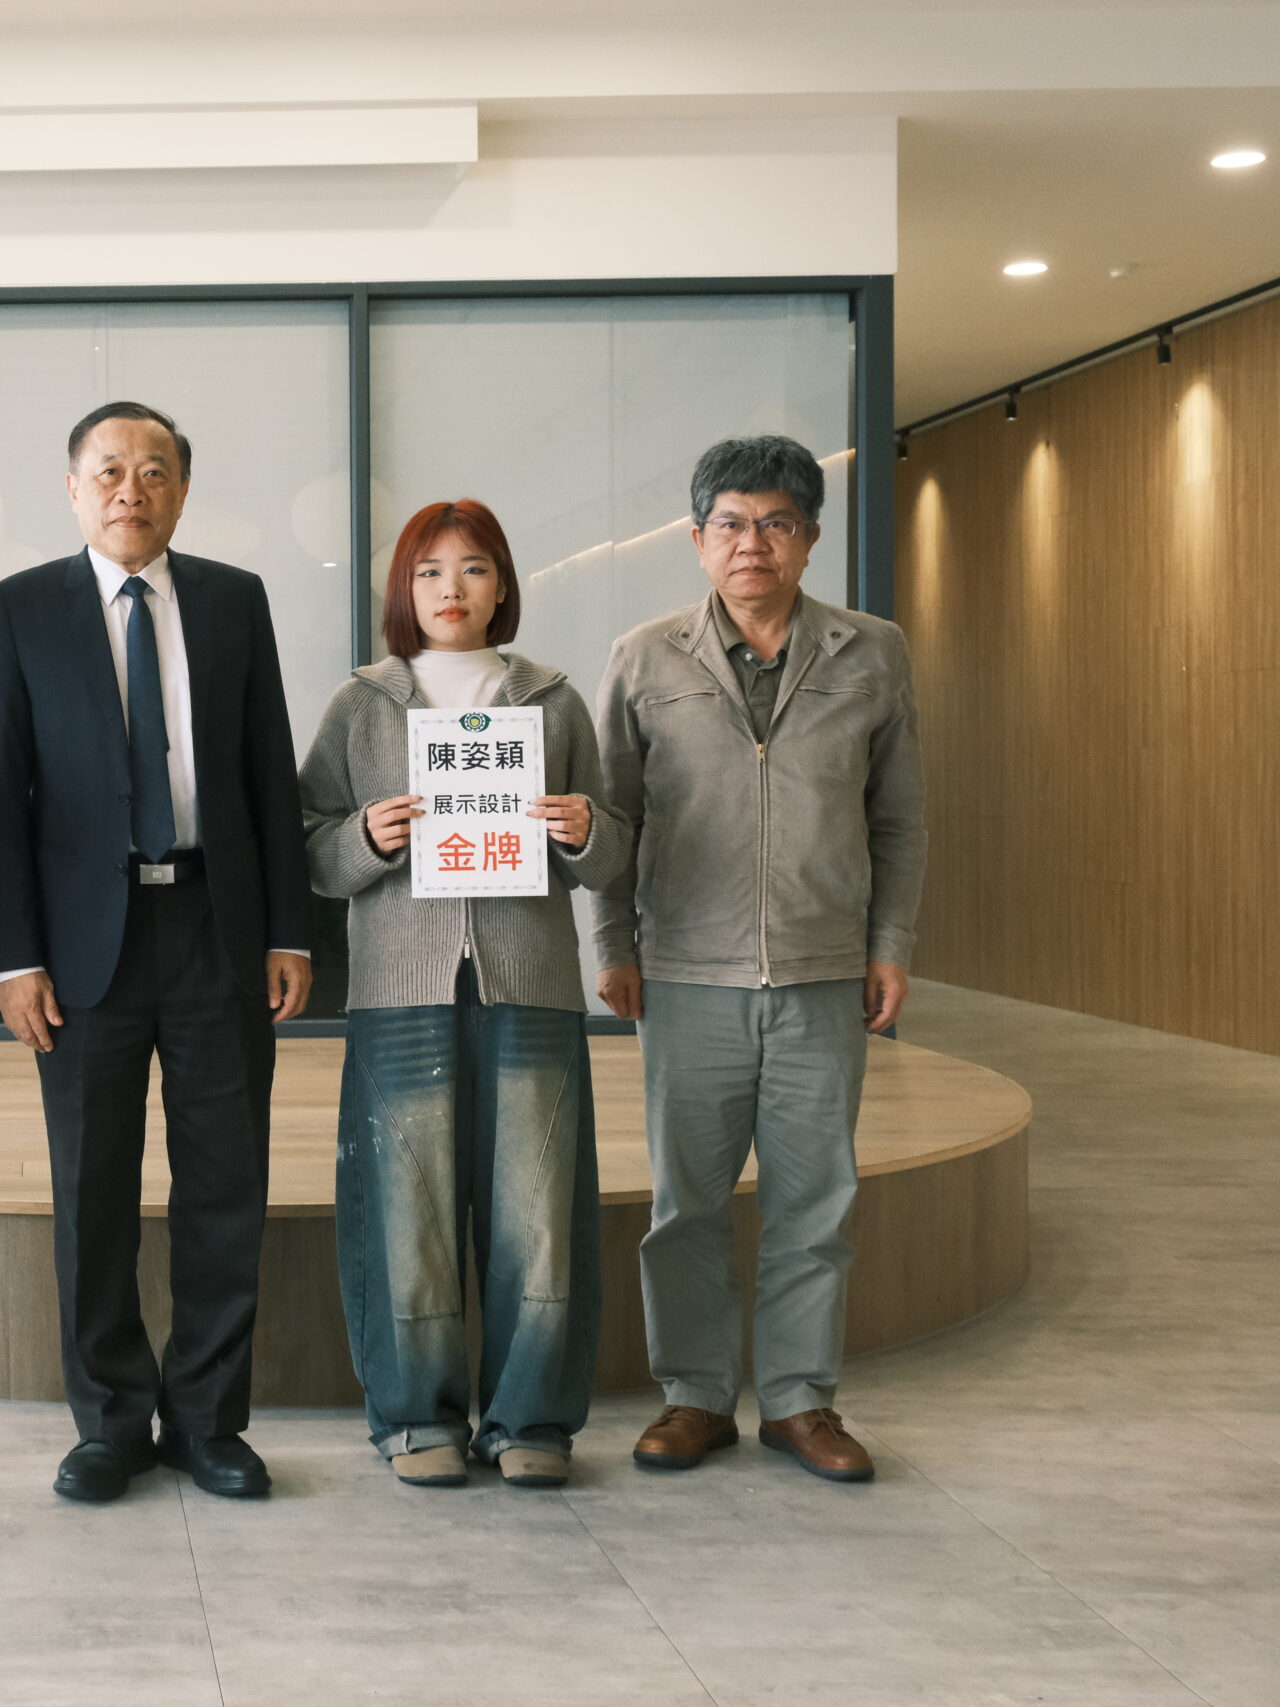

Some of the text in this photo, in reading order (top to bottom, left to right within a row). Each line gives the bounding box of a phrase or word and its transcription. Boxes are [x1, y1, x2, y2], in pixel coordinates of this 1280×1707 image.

[427, 740, 525, 772] 陳姿穎
[433, 792, 522, 815] 展示設計
[436, 831, 523, 872] 金牌
